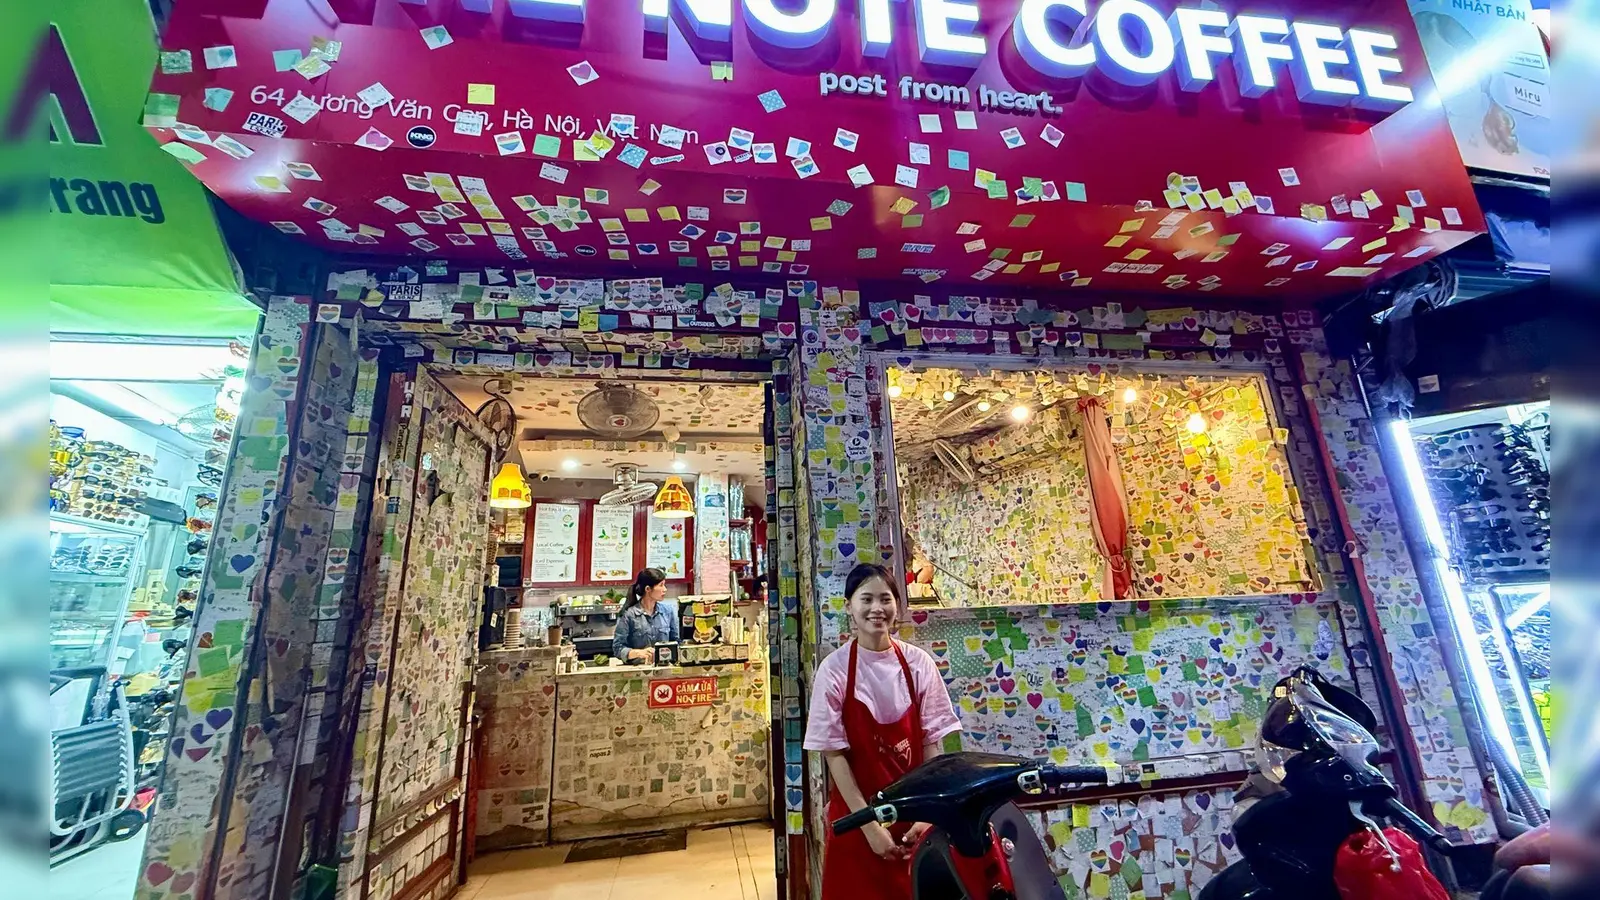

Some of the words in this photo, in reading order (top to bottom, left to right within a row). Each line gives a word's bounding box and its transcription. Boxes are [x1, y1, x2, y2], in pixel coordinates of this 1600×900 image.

[1496, 5, 1526, 20] BẢN
[1021, 0, 1414, 102] COFFEE
[819, 72, 888, 96] post
[899, 76, 970, 104] from
[979, 84, 1063, 113] heart.
[1514, 86, 1541, 102] Miru
[250, 85, 285, 106] 64
[503, 108, 534, 130] Hà
[545, 114, 586, 139] Nội,
[650, 123, 699, 144] Nm
[390, 285, 421, 296] PARIS
[676, 695, 689, 704] NO
[691, 693, 712, 703] FIRE
